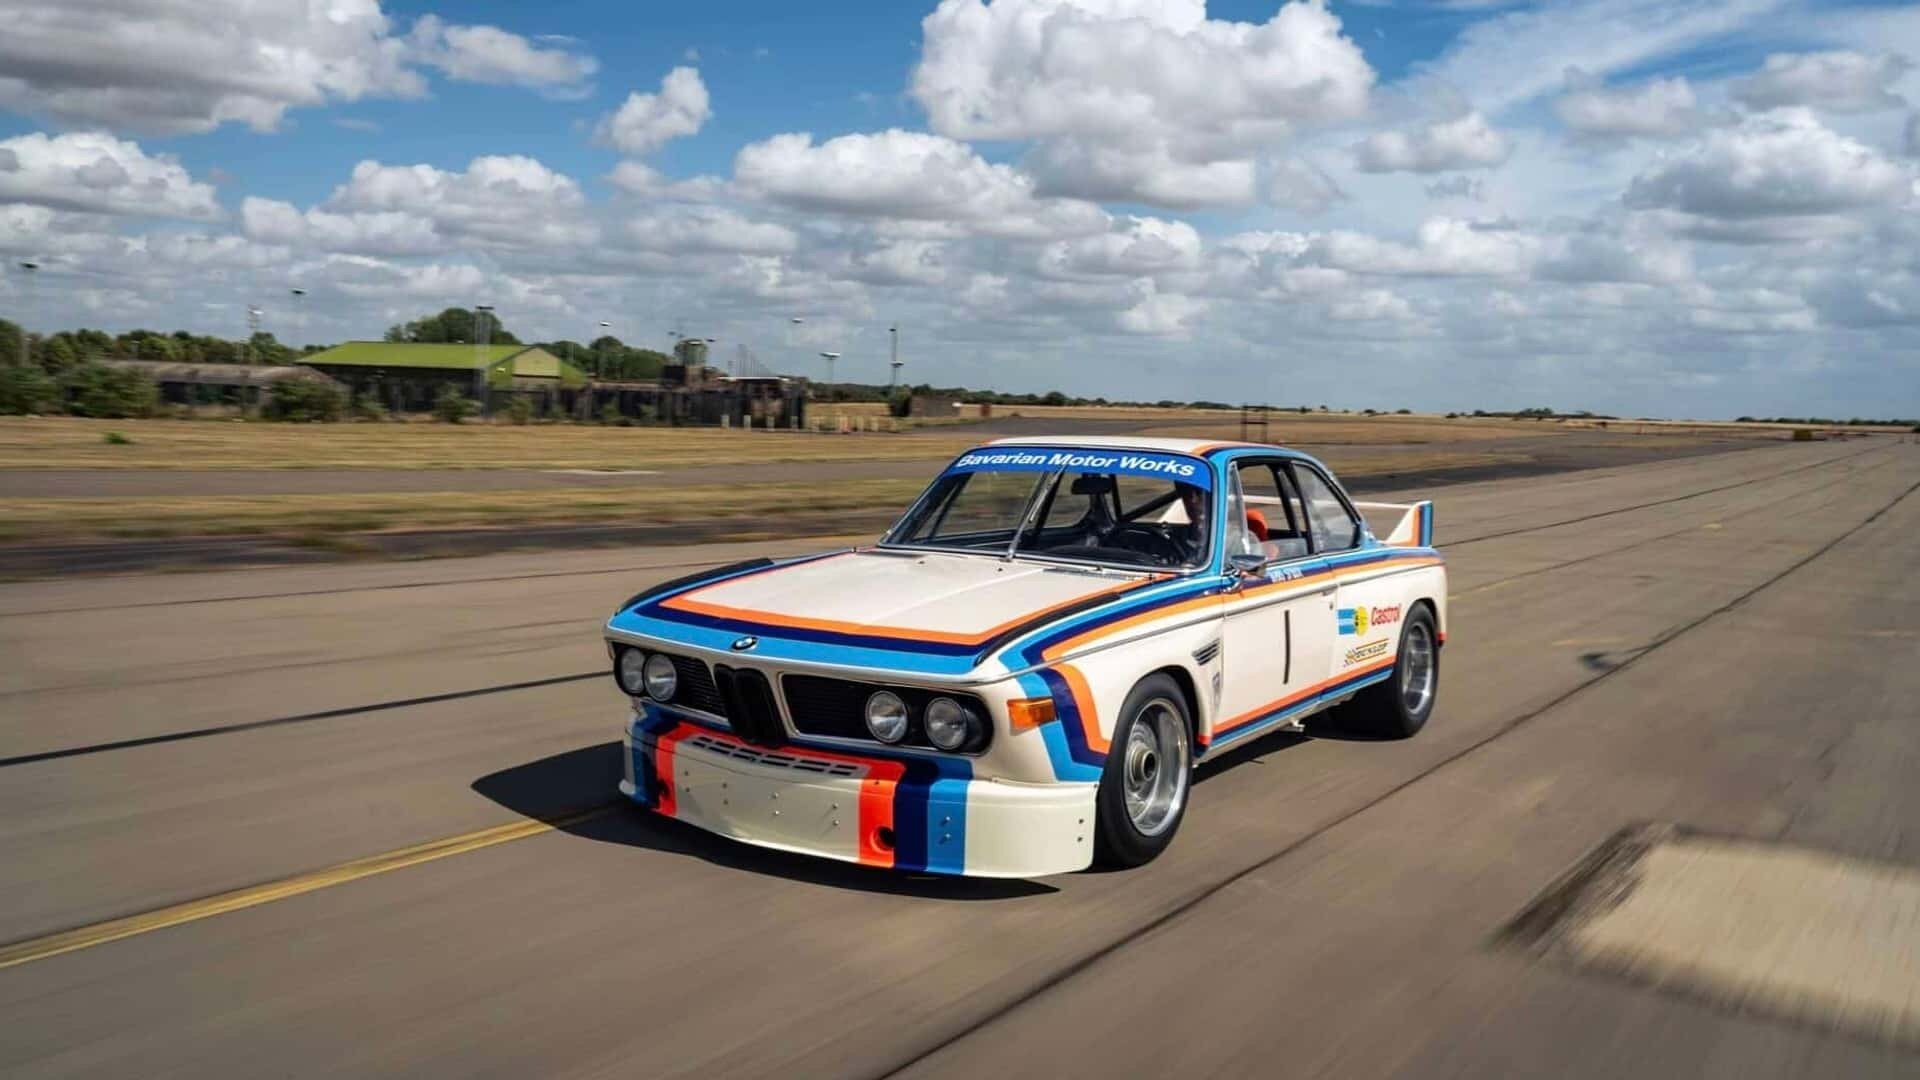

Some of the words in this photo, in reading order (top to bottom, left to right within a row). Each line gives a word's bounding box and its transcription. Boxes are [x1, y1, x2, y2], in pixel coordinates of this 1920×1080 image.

[957, 453, 1045, 468] Bavarian
[1049, 453, 1118, 468] Motor
[1119, 456, 1196, 476] Works
[1371, 604, 1402, 625] Castrol
